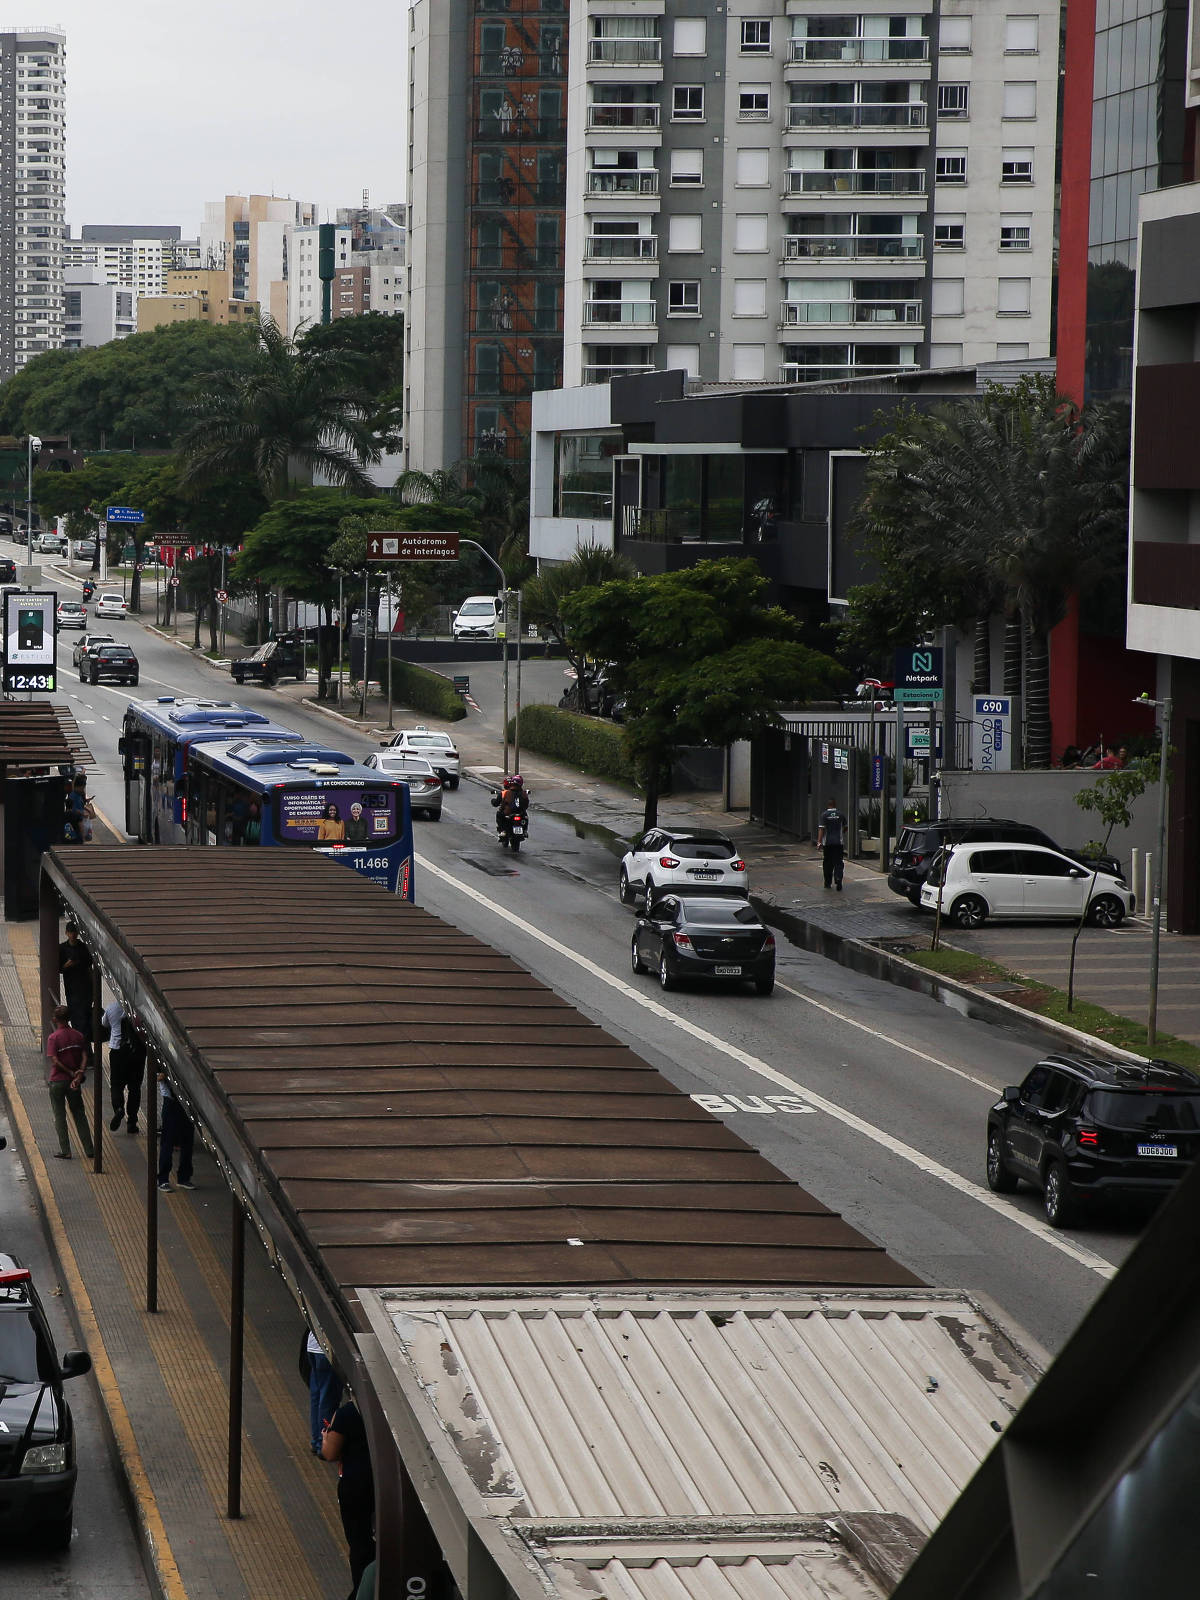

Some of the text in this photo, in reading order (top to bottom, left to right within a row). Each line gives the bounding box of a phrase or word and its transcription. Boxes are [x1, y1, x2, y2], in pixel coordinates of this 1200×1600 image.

[402, 537, 447, 545] Autódromo
[414, 548, 455, 556] Interlagos
[9, 675, 46, 689] 12:43
[905, 674, 938, 683] Netpark
[983, 701, 1002, 712] 690
[353, 858, 389, 869] 11.466
[690, 1094, 818, 1114] BUS
